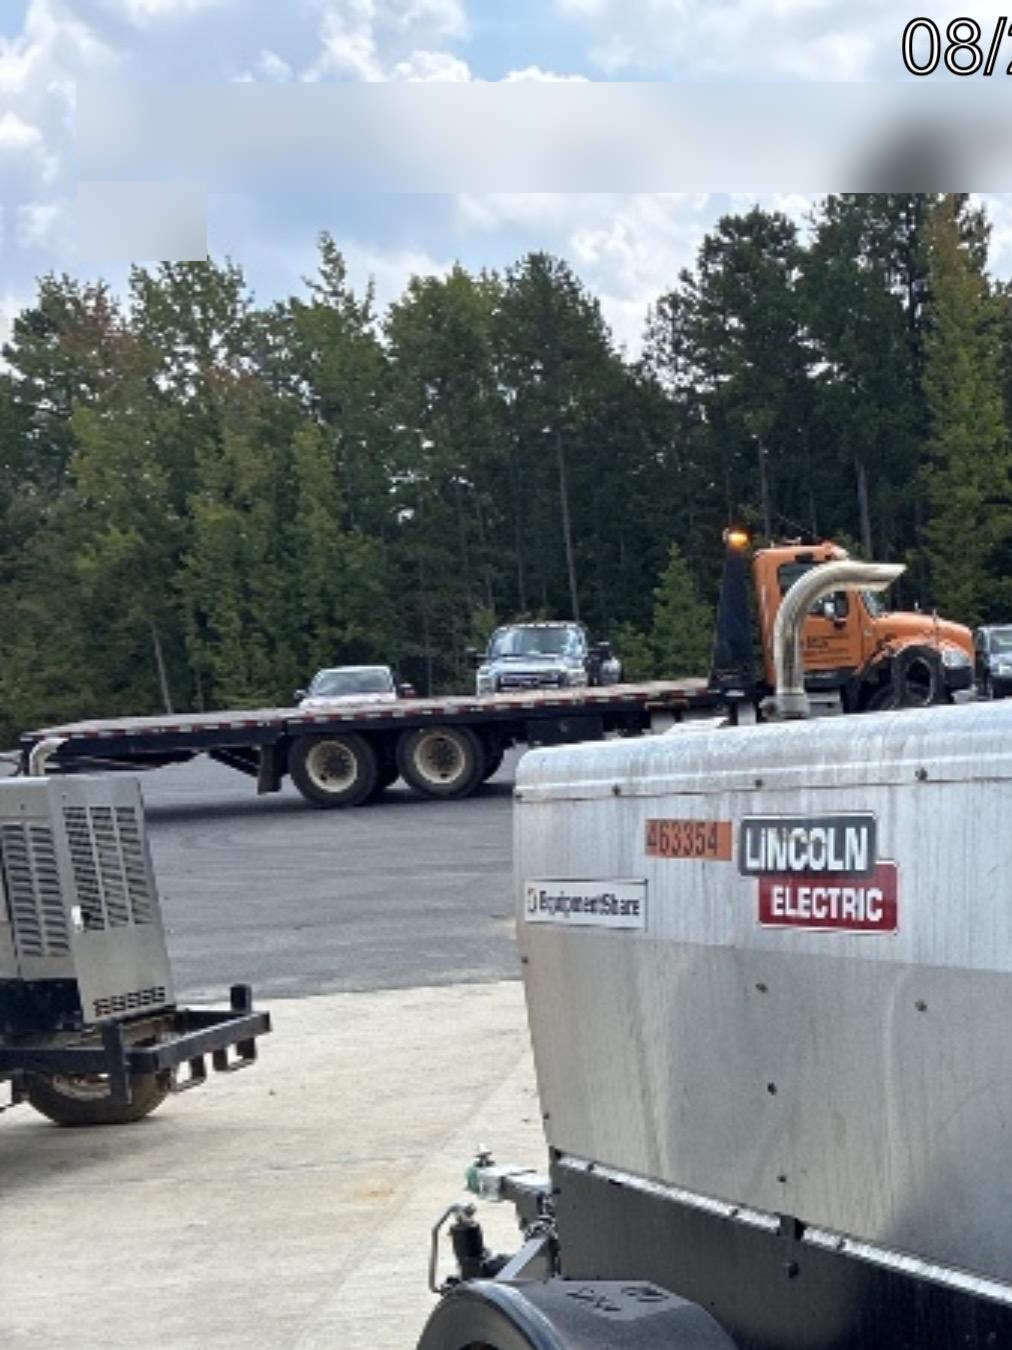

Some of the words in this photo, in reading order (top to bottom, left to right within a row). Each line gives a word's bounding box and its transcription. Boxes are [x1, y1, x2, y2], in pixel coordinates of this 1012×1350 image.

[646, 820, 719, 856] 463354
[745, 825, 868, 873] LINCOLN
[771, 885, 884, 922] ELECTRIC
